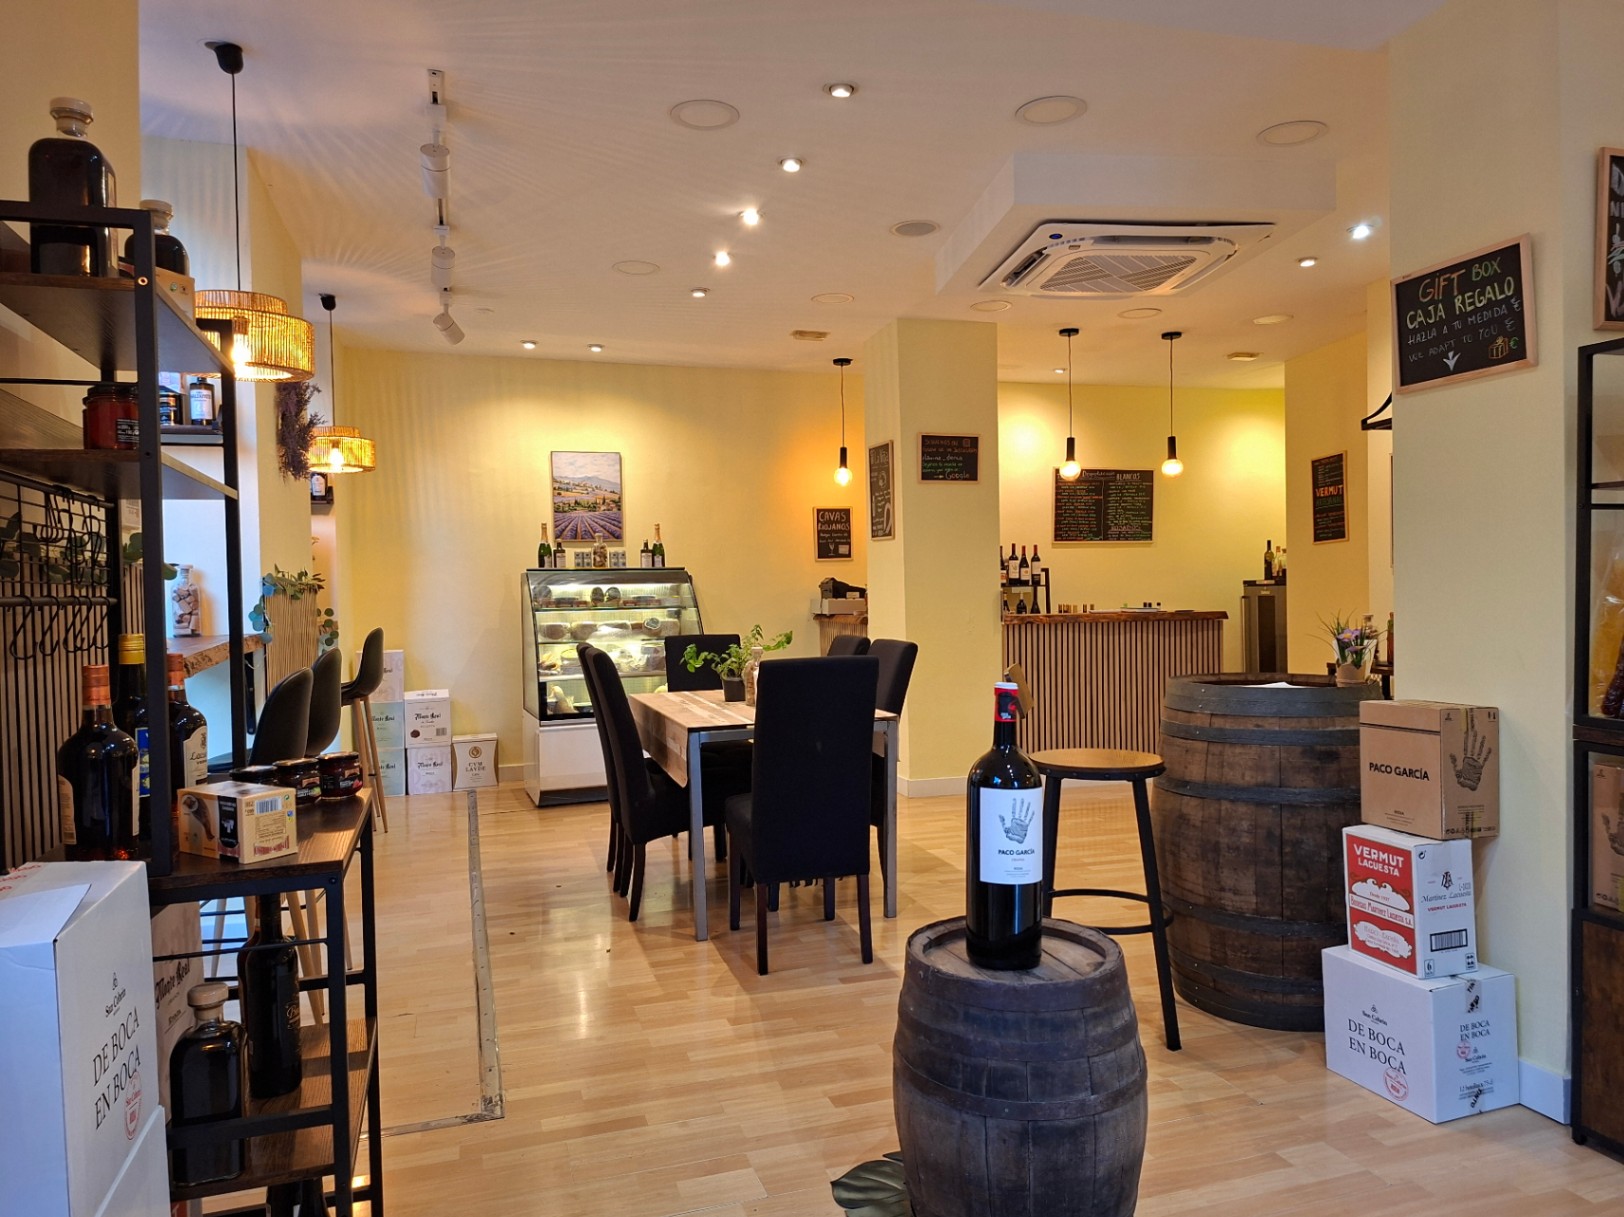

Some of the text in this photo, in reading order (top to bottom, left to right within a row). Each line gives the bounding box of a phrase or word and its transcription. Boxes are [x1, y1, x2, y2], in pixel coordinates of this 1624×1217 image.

[1471, 256, 1501, 281] BOX
[1406, 276, 1515, 330] CAJA REGALO
[1442, 324, 1448, 334] A
[1452, 320, 1462, 329] TU
[1467, 304, 1508, 325] MEDIDA
[1428, 338, 1457, 357] ADAPT
[1478, 323, 1498, 341] YOU
[945, 470, 970, 480] Google
[1315, 484, 1344, 498] VERMUT
[818, 511, 847, 522] CAVAS
[1369, 762, 1430, 782] PACO GARCÍA
[1015, 848, 1035, 856] GARCÍA
[1353, 843, 1404, 868] VERMUT
[1358, 857, 1400, 877] LACUESTA
[1426, 961, 1432, 971] 6
[1347, 1018, 1406, 1056] DE BOCA
[1460, 1019, 1490, 1033] DE BOCA
[1460, 1027, 1490, 1042] EN BOCA
[92, 1042, 110, 1088] DE
[111, 1004, 140, 1064] BOCA
[1348, 1036, 1407, 1076] EN BOCA
[95, 1084, 111, 1131] EN
[113, 1044, 142, 1105] BOCA
